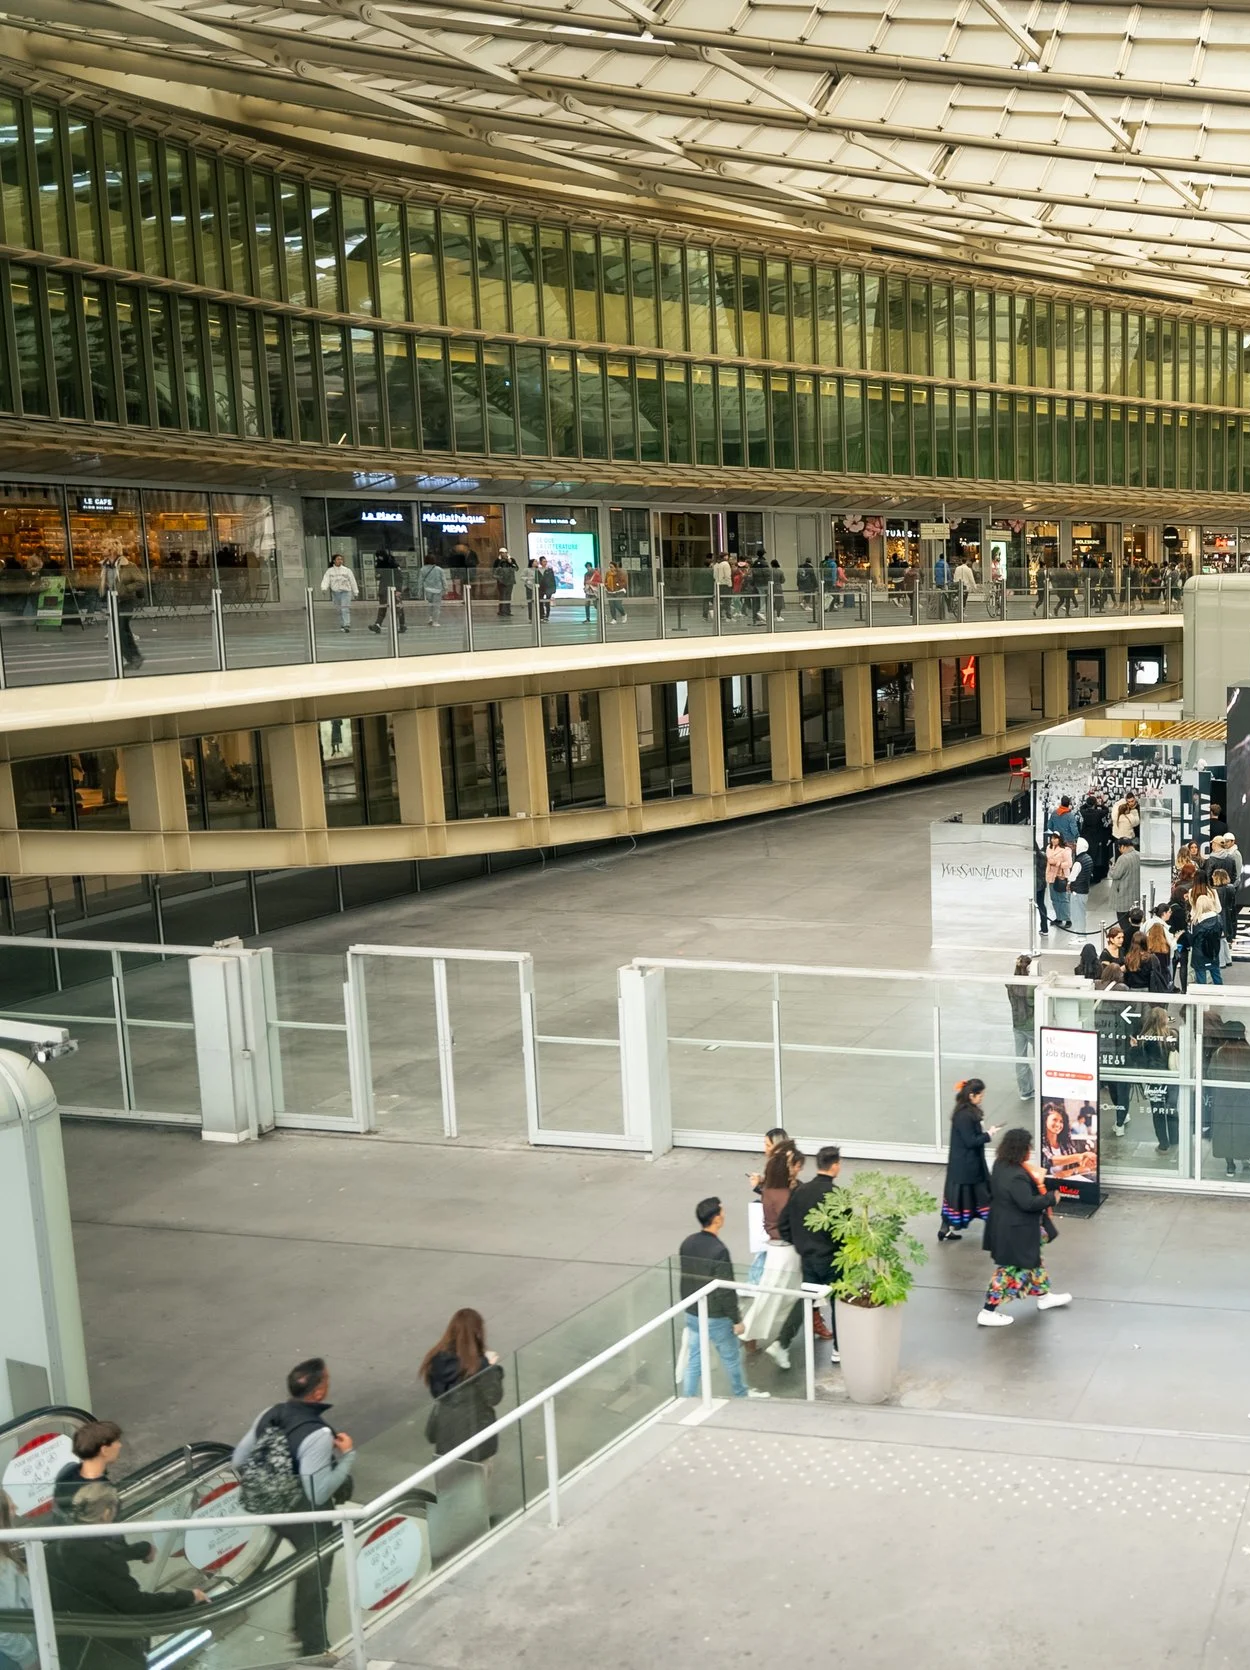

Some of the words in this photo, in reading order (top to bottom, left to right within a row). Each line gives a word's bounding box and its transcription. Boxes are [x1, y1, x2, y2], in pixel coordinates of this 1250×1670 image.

[422, 512, 486, 525] Médiathèque
[1088, 775, 1144, 790] MYSLFIE
[1060, 1050, 1086, 1062] dating
[1139, 1106, 1175, 1115] ESPRIT
